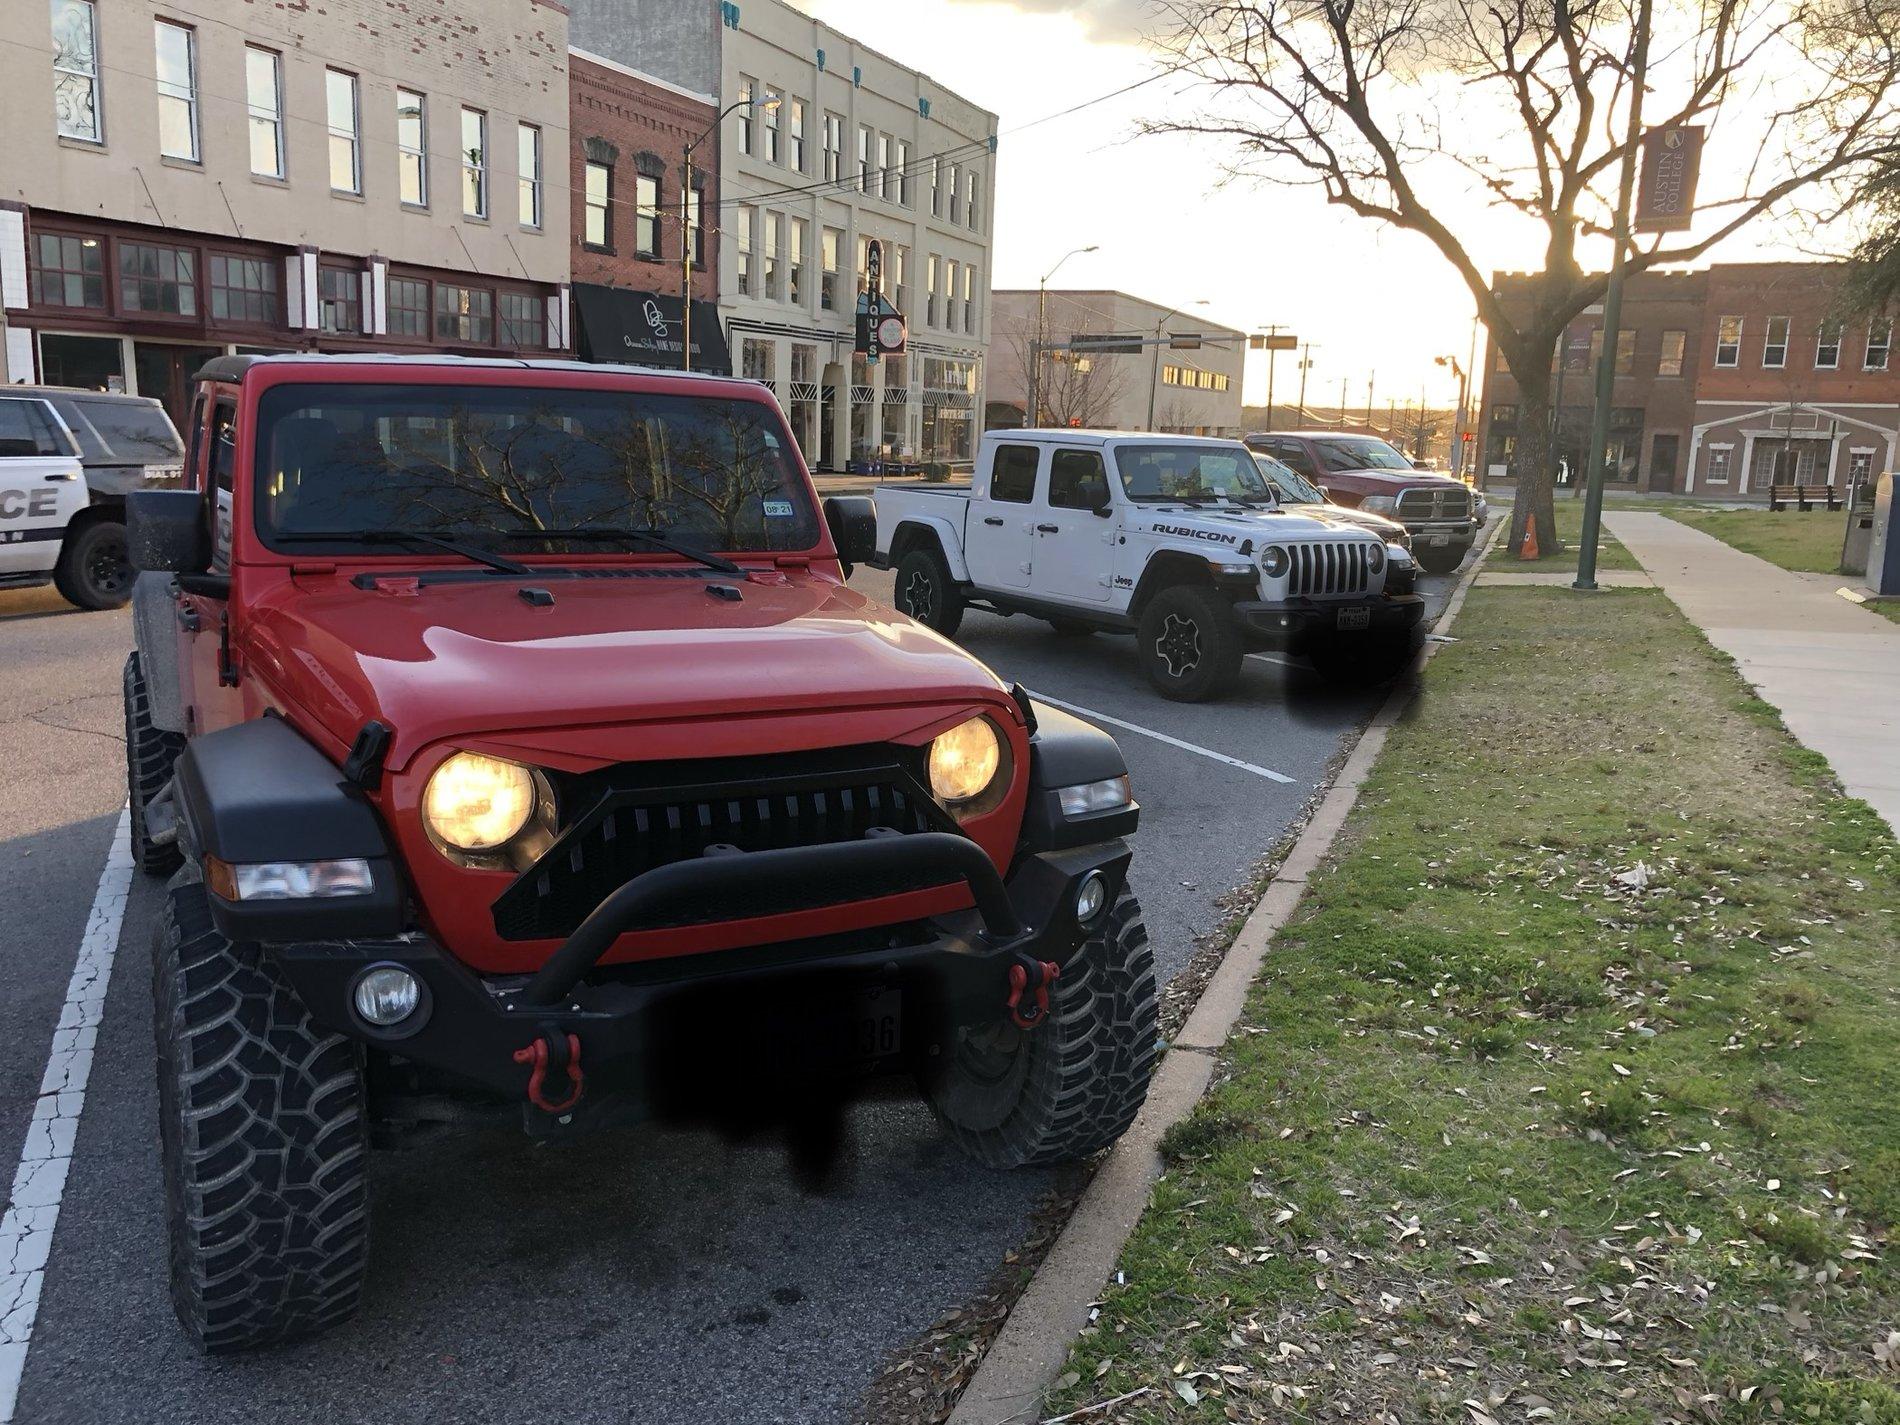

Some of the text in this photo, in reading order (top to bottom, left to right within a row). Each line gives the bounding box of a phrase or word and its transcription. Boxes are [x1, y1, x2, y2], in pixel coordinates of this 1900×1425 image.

[1653, 151, 1672, 212] AUSTIN
[1666, 151, 1684, 212] COLLEGE
[869, 250, 878, 355] ANTIQUES
[1152, 523, 1236, 544] RUBICON
[1115, 575, 1133, 587] Jeep
